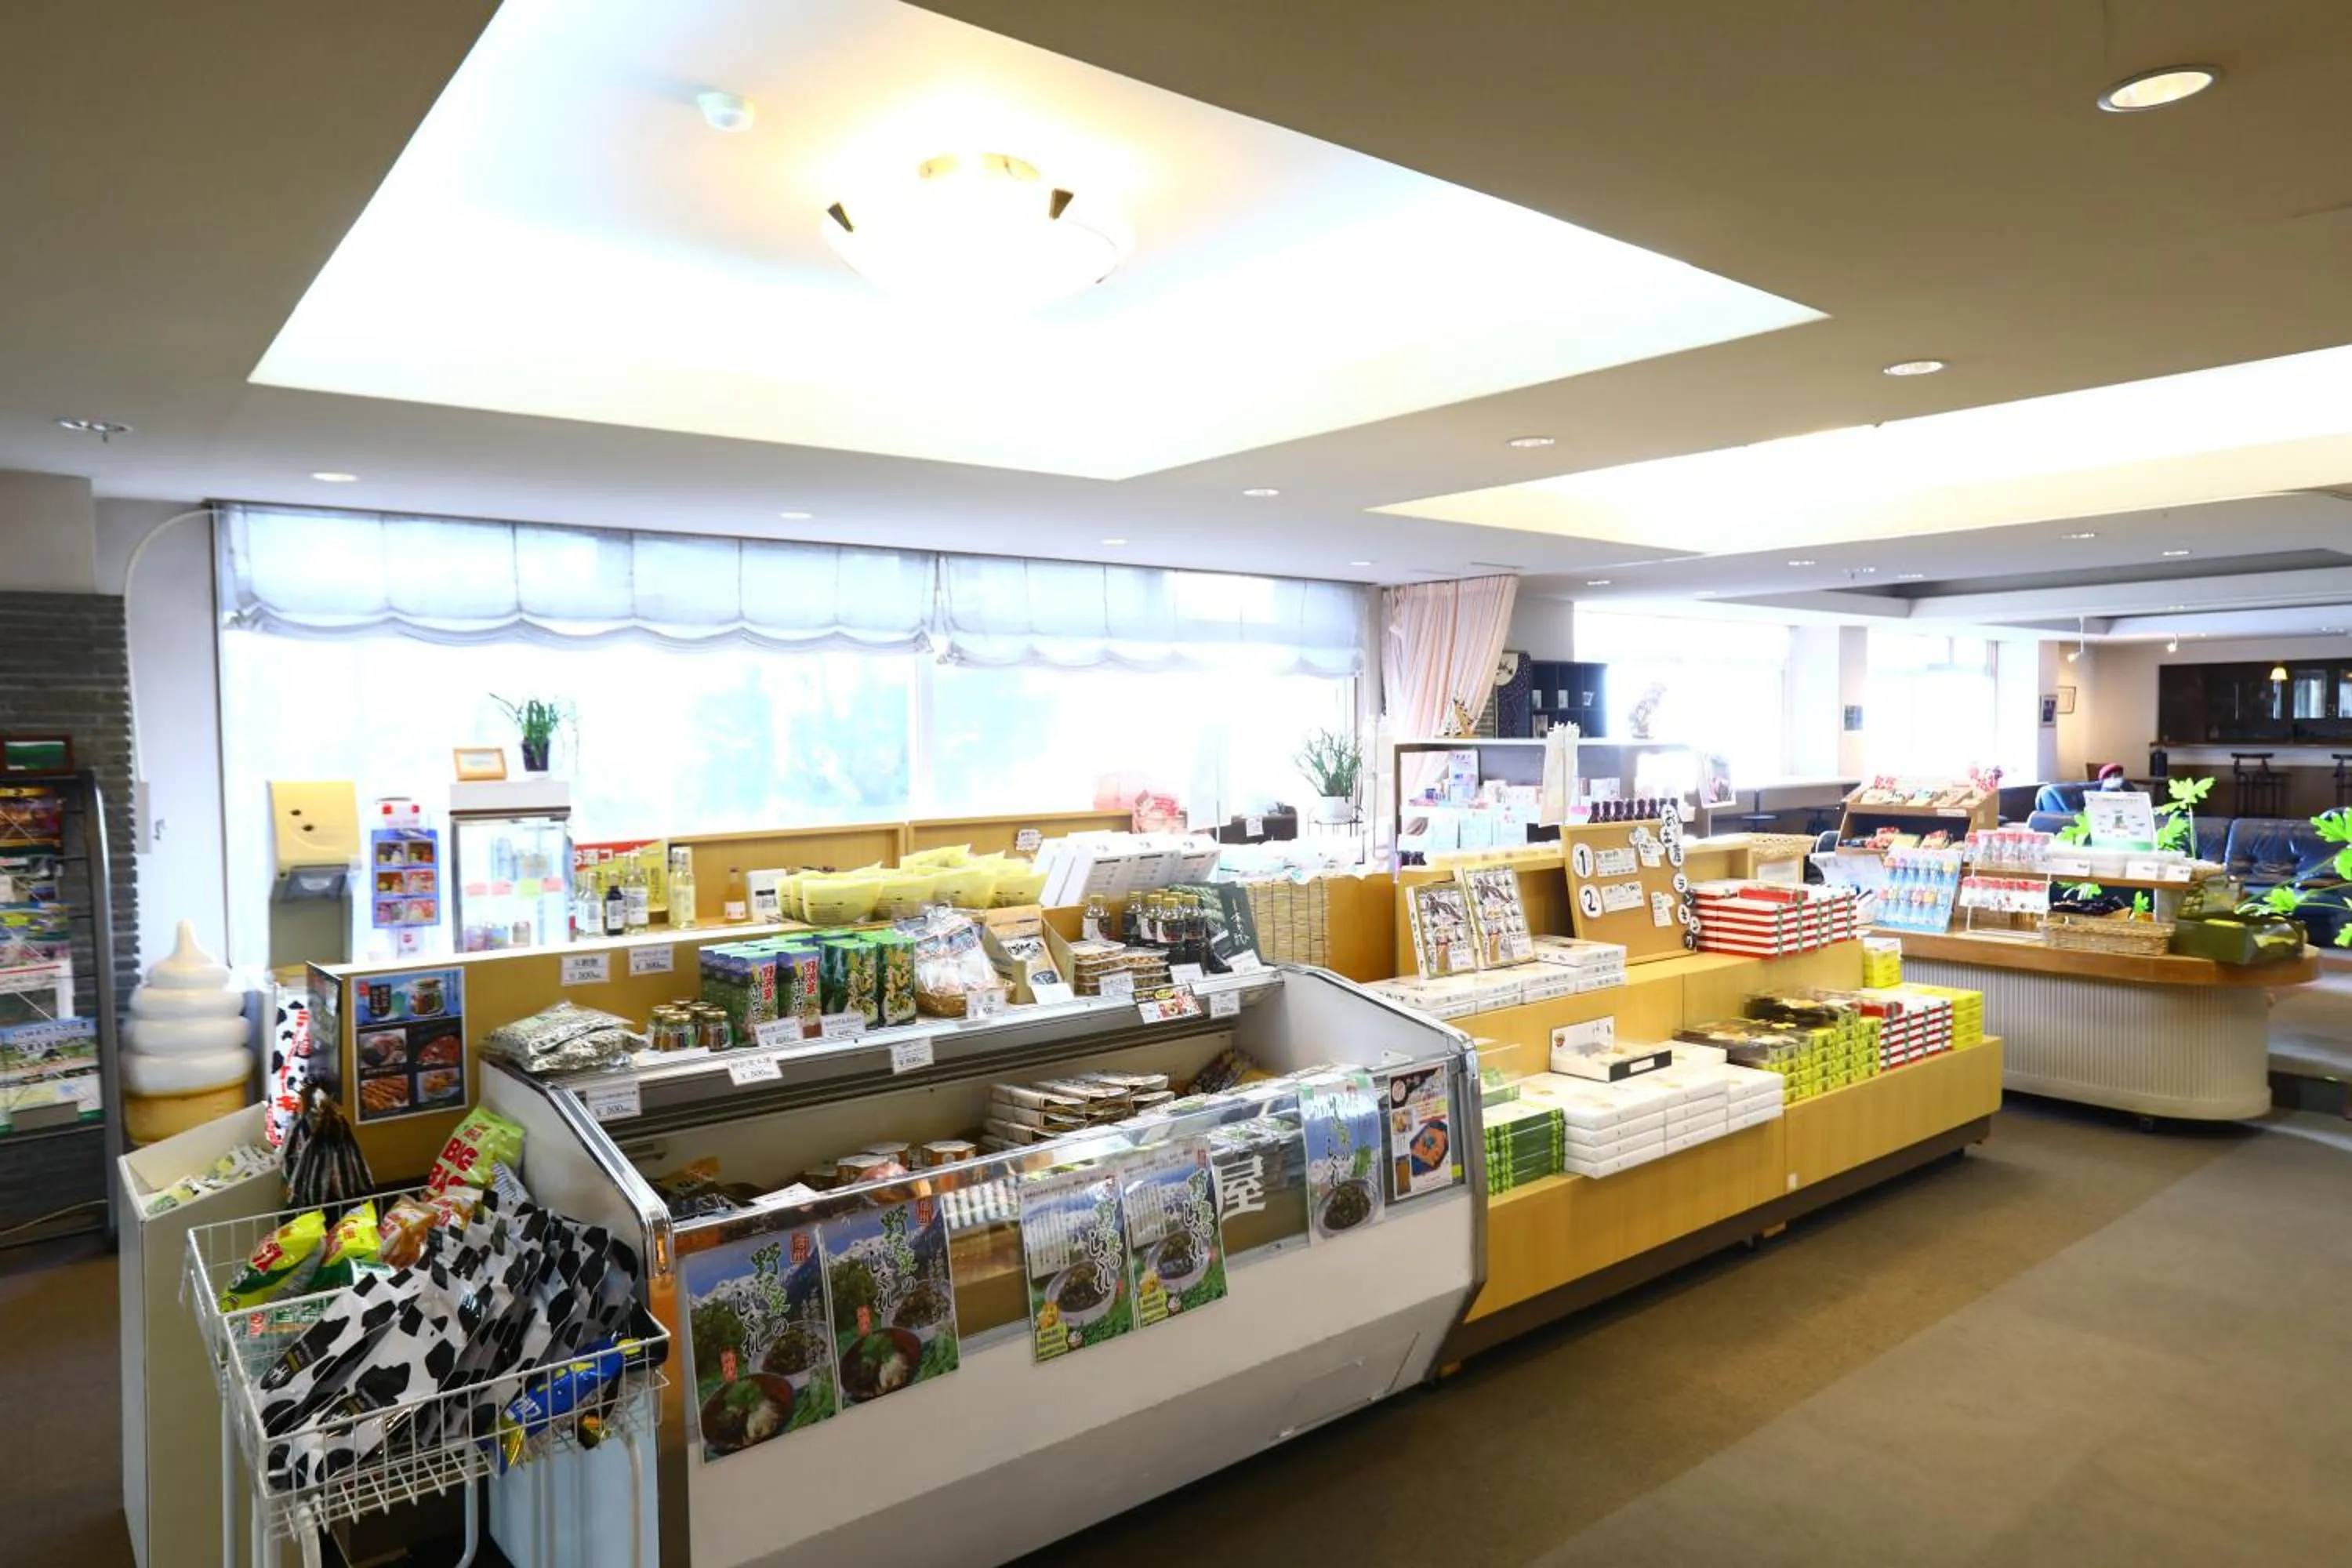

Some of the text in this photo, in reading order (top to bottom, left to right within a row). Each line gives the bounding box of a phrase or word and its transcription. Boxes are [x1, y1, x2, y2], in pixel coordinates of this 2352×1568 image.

[1578, 849, 1586, 876] 1
[1584, 889, 1597, 912] 2
[441, 1137, 479, 1172] BIG
